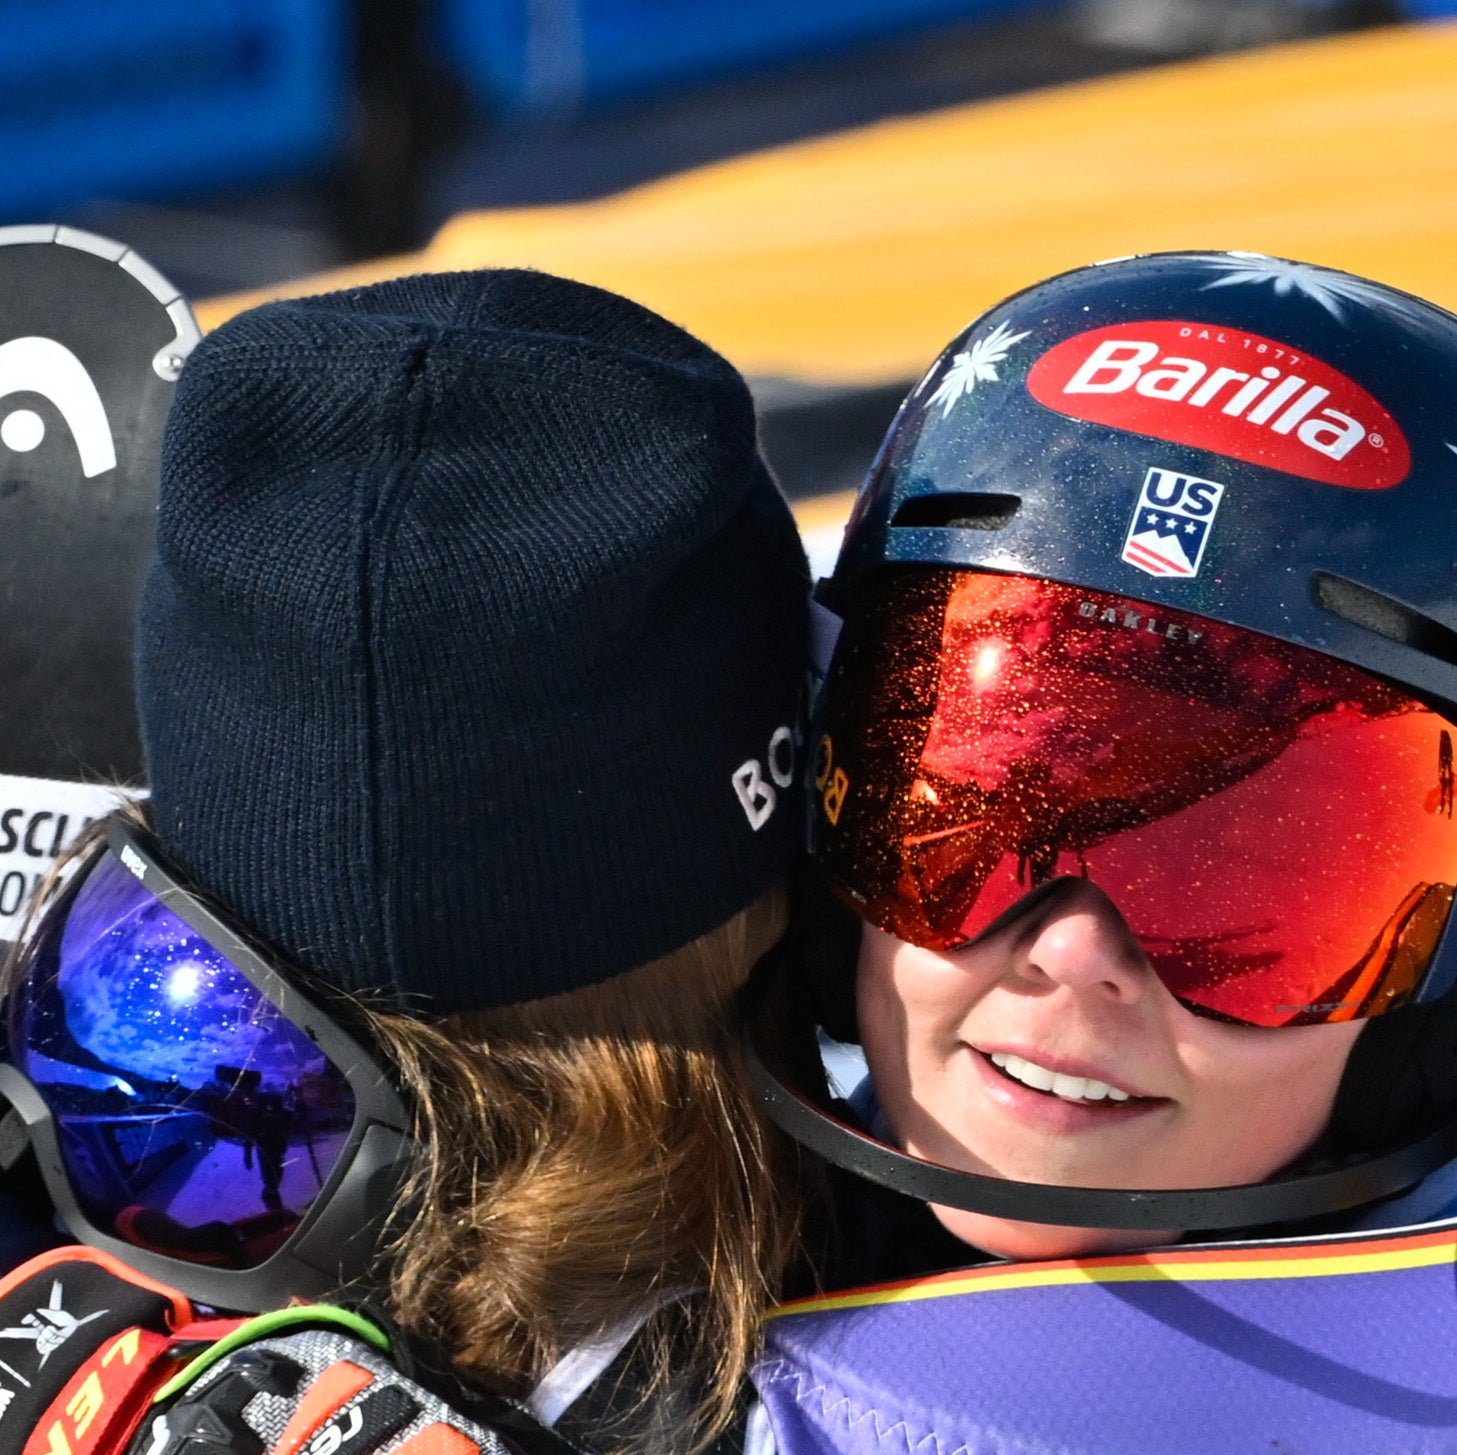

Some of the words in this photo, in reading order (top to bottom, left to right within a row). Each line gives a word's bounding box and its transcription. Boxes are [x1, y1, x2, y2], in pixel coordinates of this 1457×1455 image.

[1179, 326, 1227, 345] DAL
[1243, 338, 1301, 367] 1877
[1146, 471, 1218, 517] US
[1078, 601, 1204, 646] OAKLEY
